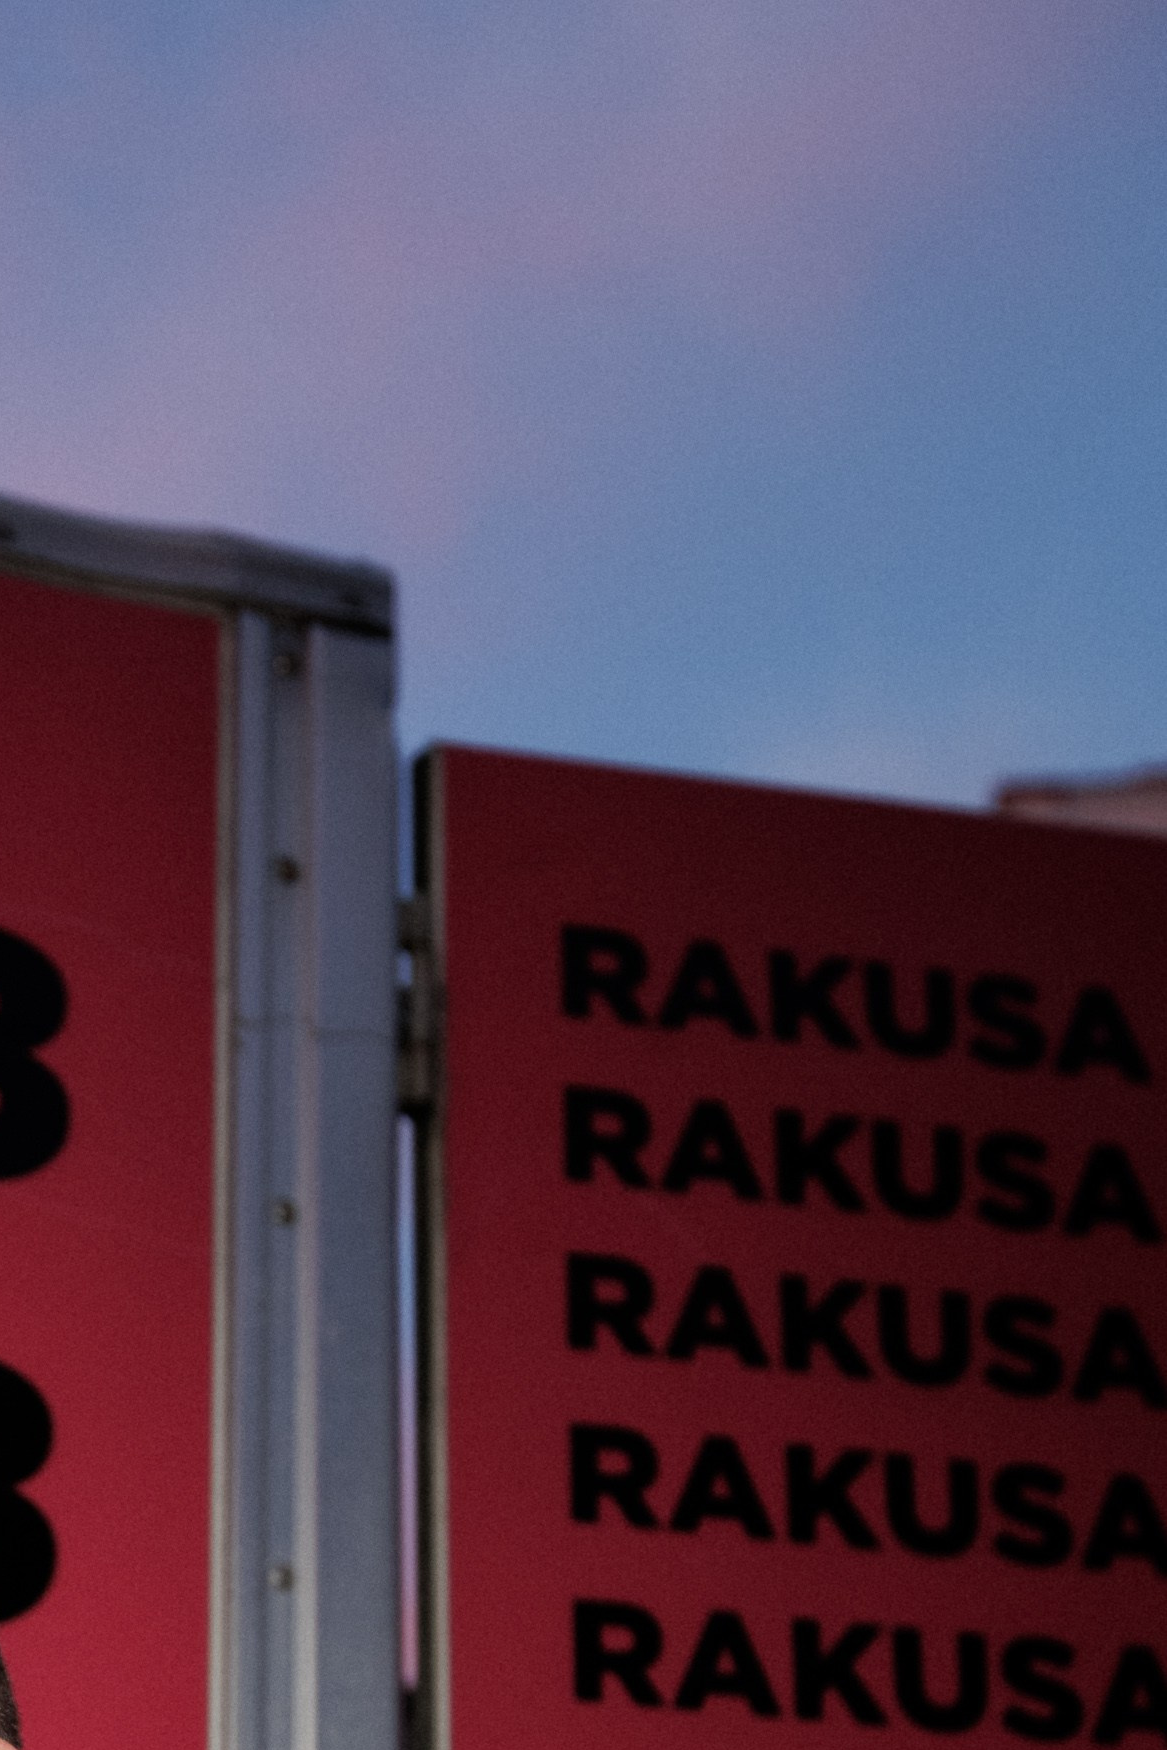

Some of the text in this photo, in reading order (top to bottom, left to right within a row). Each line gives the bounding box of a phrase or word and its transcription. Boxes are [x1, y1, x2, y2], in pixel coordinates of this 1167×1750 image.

[561, 924, 1152, 1085] RAKUSA
[563, 1085, 1164, 1245] RAKUSA
[566, 1252, 1167, 1411] RAKUSA
[569, 1422, 1167, 1579] RAKUSA
[572, 1598, 1167, 1747] RAKUSA
